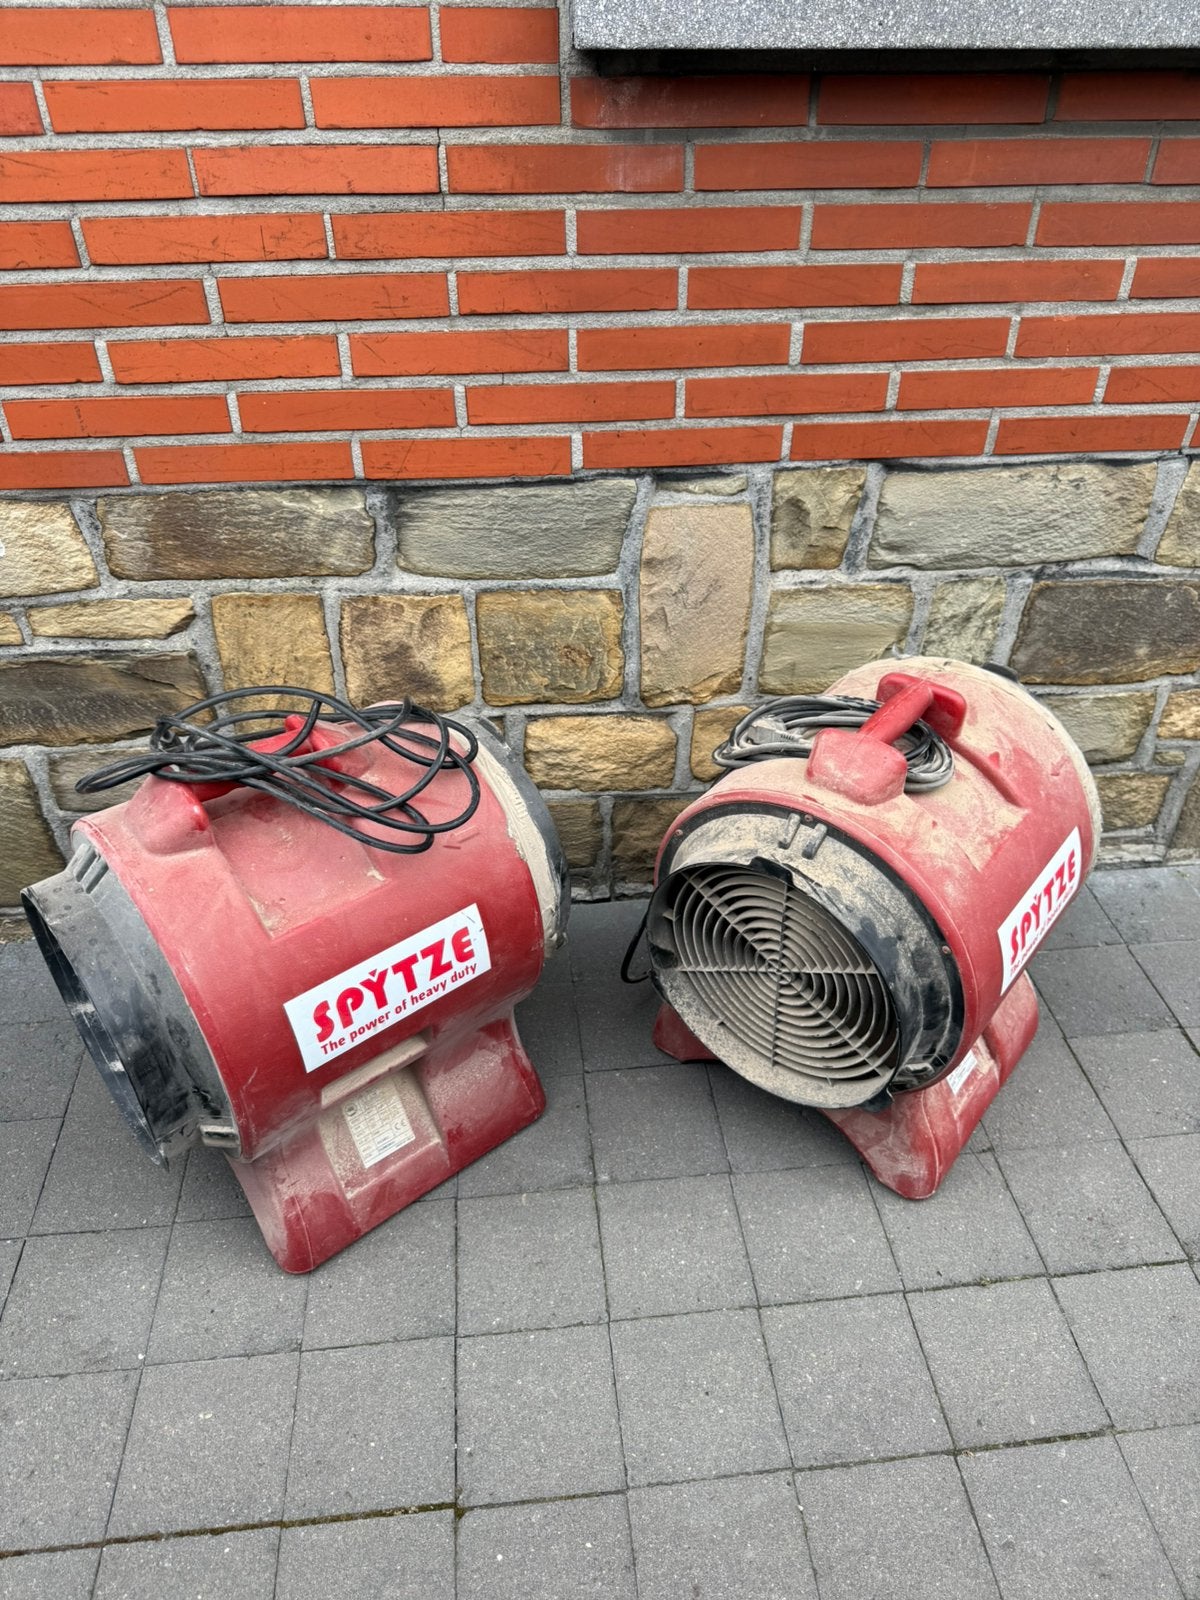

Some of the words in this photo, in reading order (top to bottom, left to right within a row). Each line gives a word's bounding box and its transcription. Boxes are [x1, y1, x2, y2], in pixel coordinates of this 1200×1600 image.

[321, 1036, 346, 1055] The
[350, 1012, 391, 1043] power
[394, 999, 408, 1016] of
[410, 979, 448, 1006] heavy
[450, 963, 477, 984] duty
